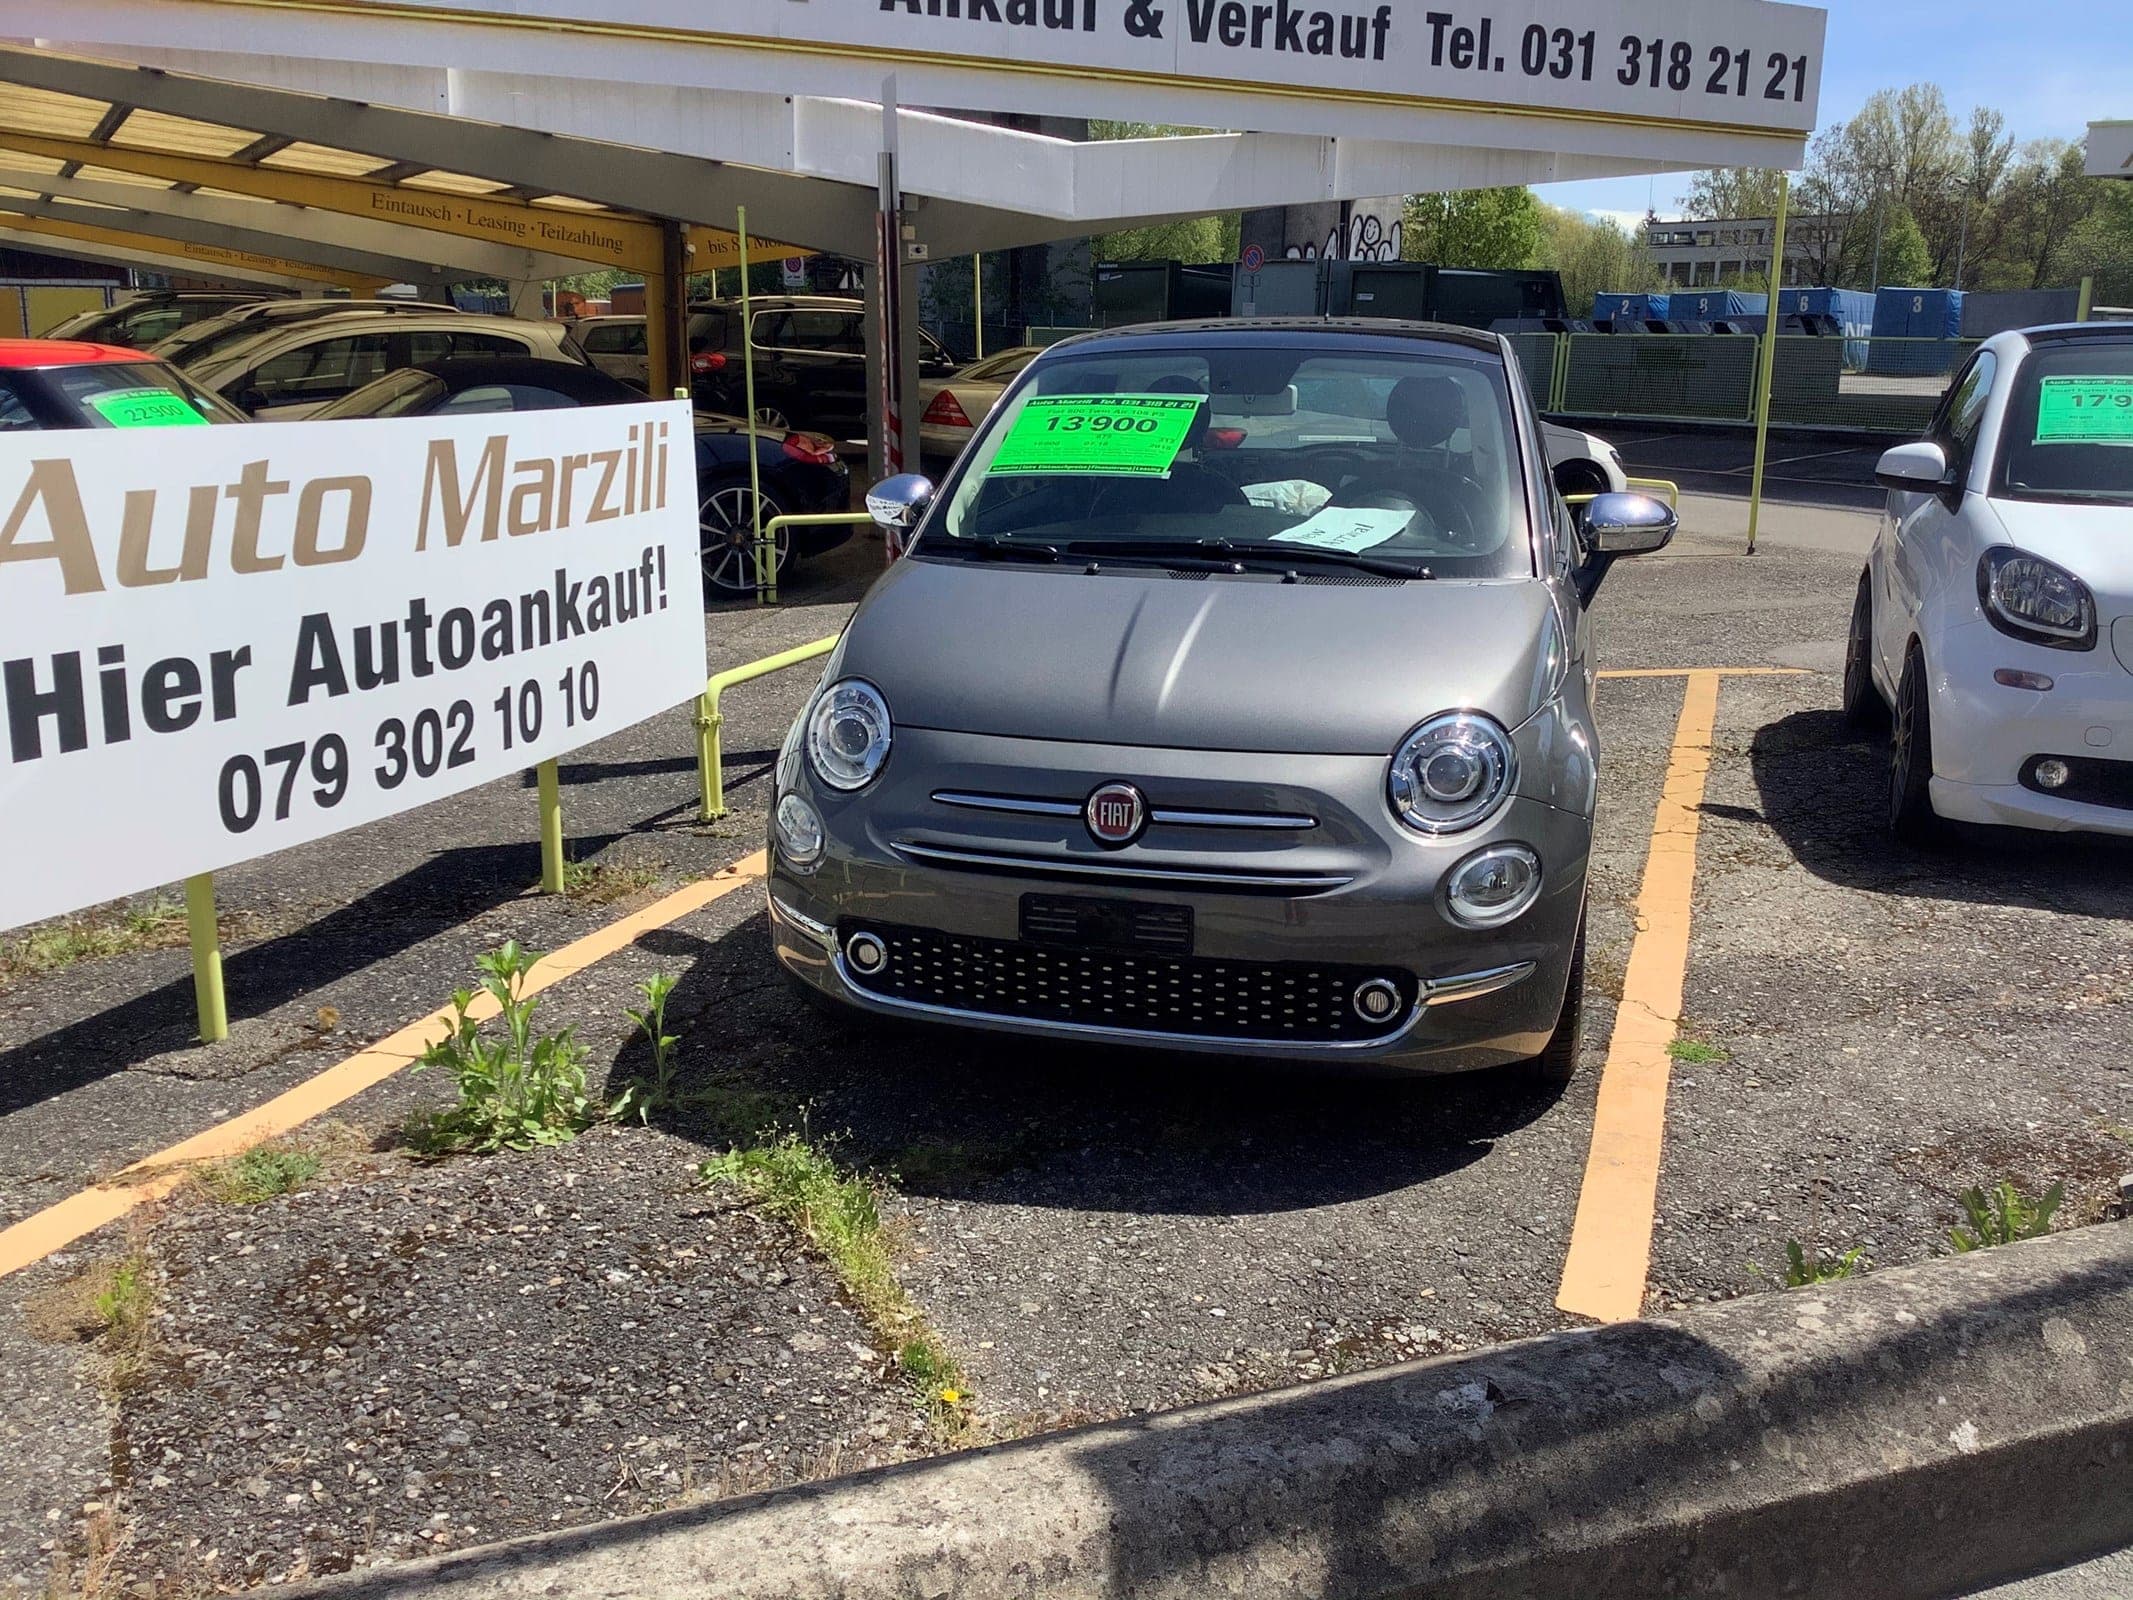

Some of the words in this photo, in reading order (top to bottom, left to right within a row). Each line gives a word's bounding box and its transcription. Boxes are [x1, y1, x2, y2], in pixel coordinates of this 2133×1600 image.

[1124, 0, 1163, 39] &
[1186, 0, 1391, 60] Verkauf
[1426, 12, 1504, 72] Tel.
[1521, 22, 1595, 82] 031
[1617, 34, 1692, 92] 318
[1705, 44, 1750, 97] 21
[1764, 52, 1808, 103] 21
[371, 192, 451, 222] Eintausch
[466, 209, 526, 236] Leasing
[537, 221, 623, 253] Teilzahlung
[707, 240, 728, 254] bis
[1621, 299, 1630, 315] 2
[1912, 295, 1922, 313] 3
[1029, 399, 1055, 407] Auto
[1121, 399, 1140, 407] 031
[1046, 416, 1159, 433] 13'900
[0, 458, 372, 597] Auto
[416, 421, 668, 552] Marzili
[3, 643, 252, 764] Hier
[287, 545, 668, 707] Autoankauf!
[218, 733, 349, 834] 079
[374, 698, 475, 790] 302
[493, 678, 541, 752] 10
[558, 660, 600, 727] 10
[1101, 801, 1132, 826] FIAT
